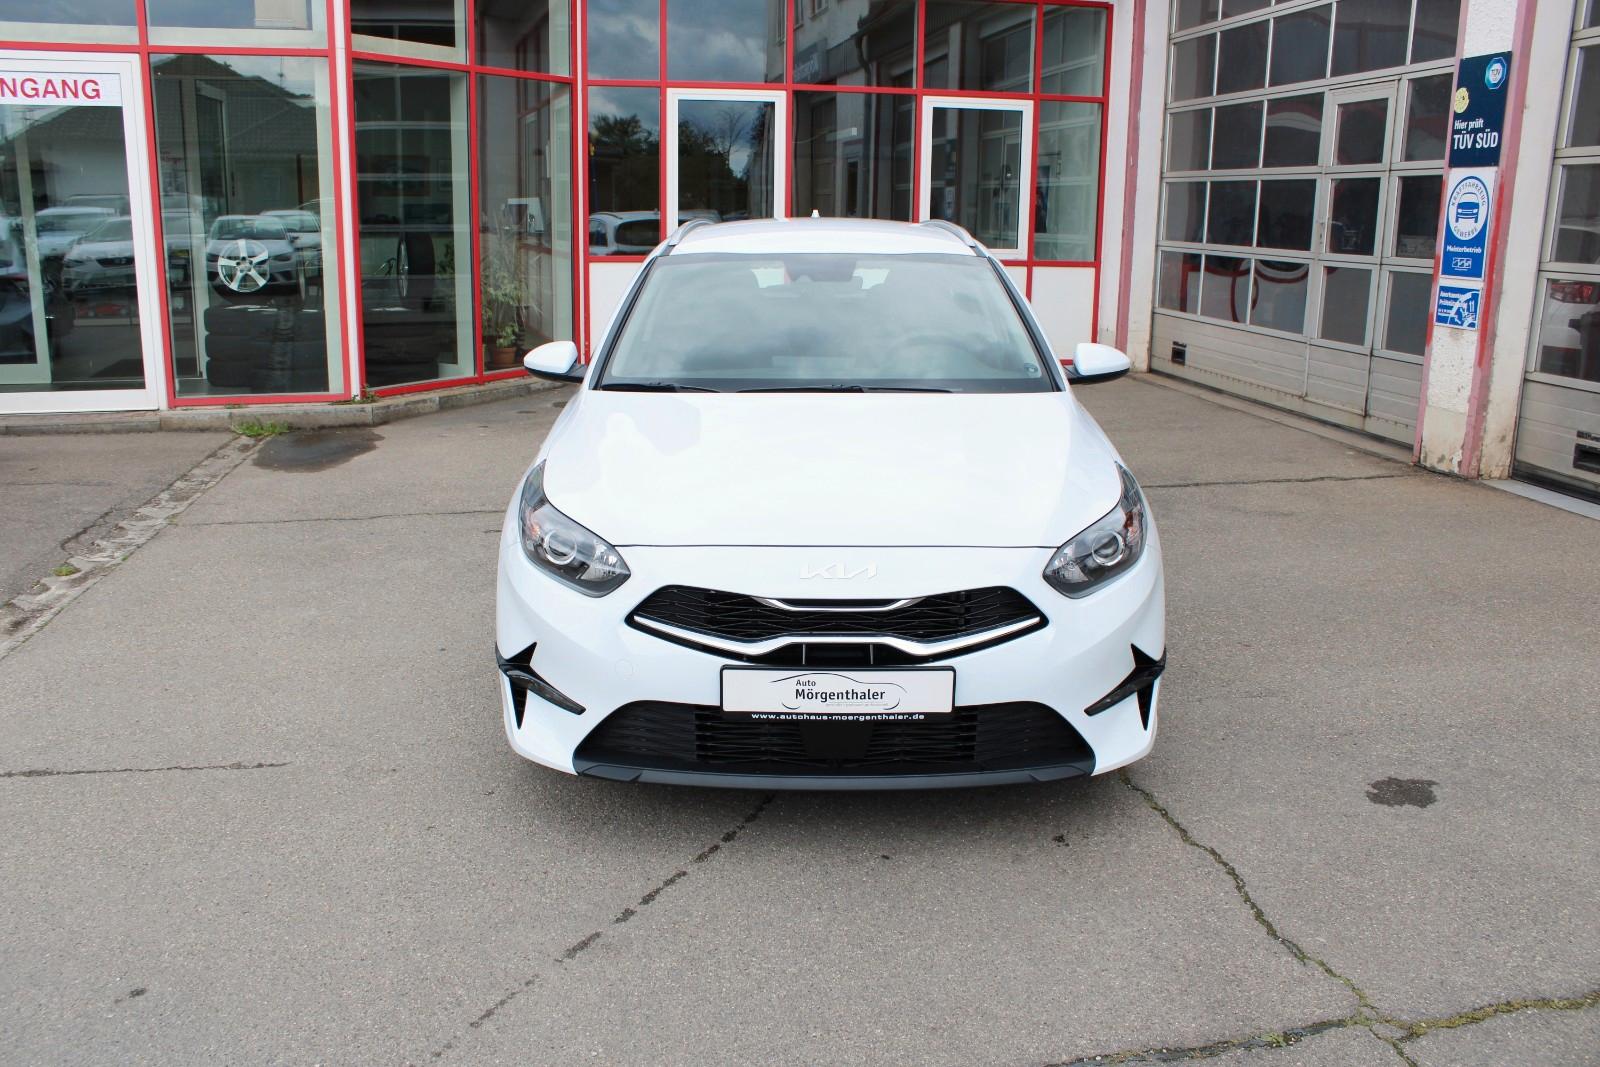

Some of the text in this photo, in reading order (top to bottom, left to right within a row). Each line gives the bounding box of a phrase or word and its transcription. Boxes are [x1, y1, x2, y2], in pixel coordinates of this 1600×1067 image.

[1454, 118, 1484, 131] Hier prüft
[1453, 129, 1498, 149] TÜV SÜD
[795, 679, 817, 687] Auto
[795, 688, 886, 703] Mörgenthaler
[751, 712, 925, 721] www.autohaus-moergenthaler.de
